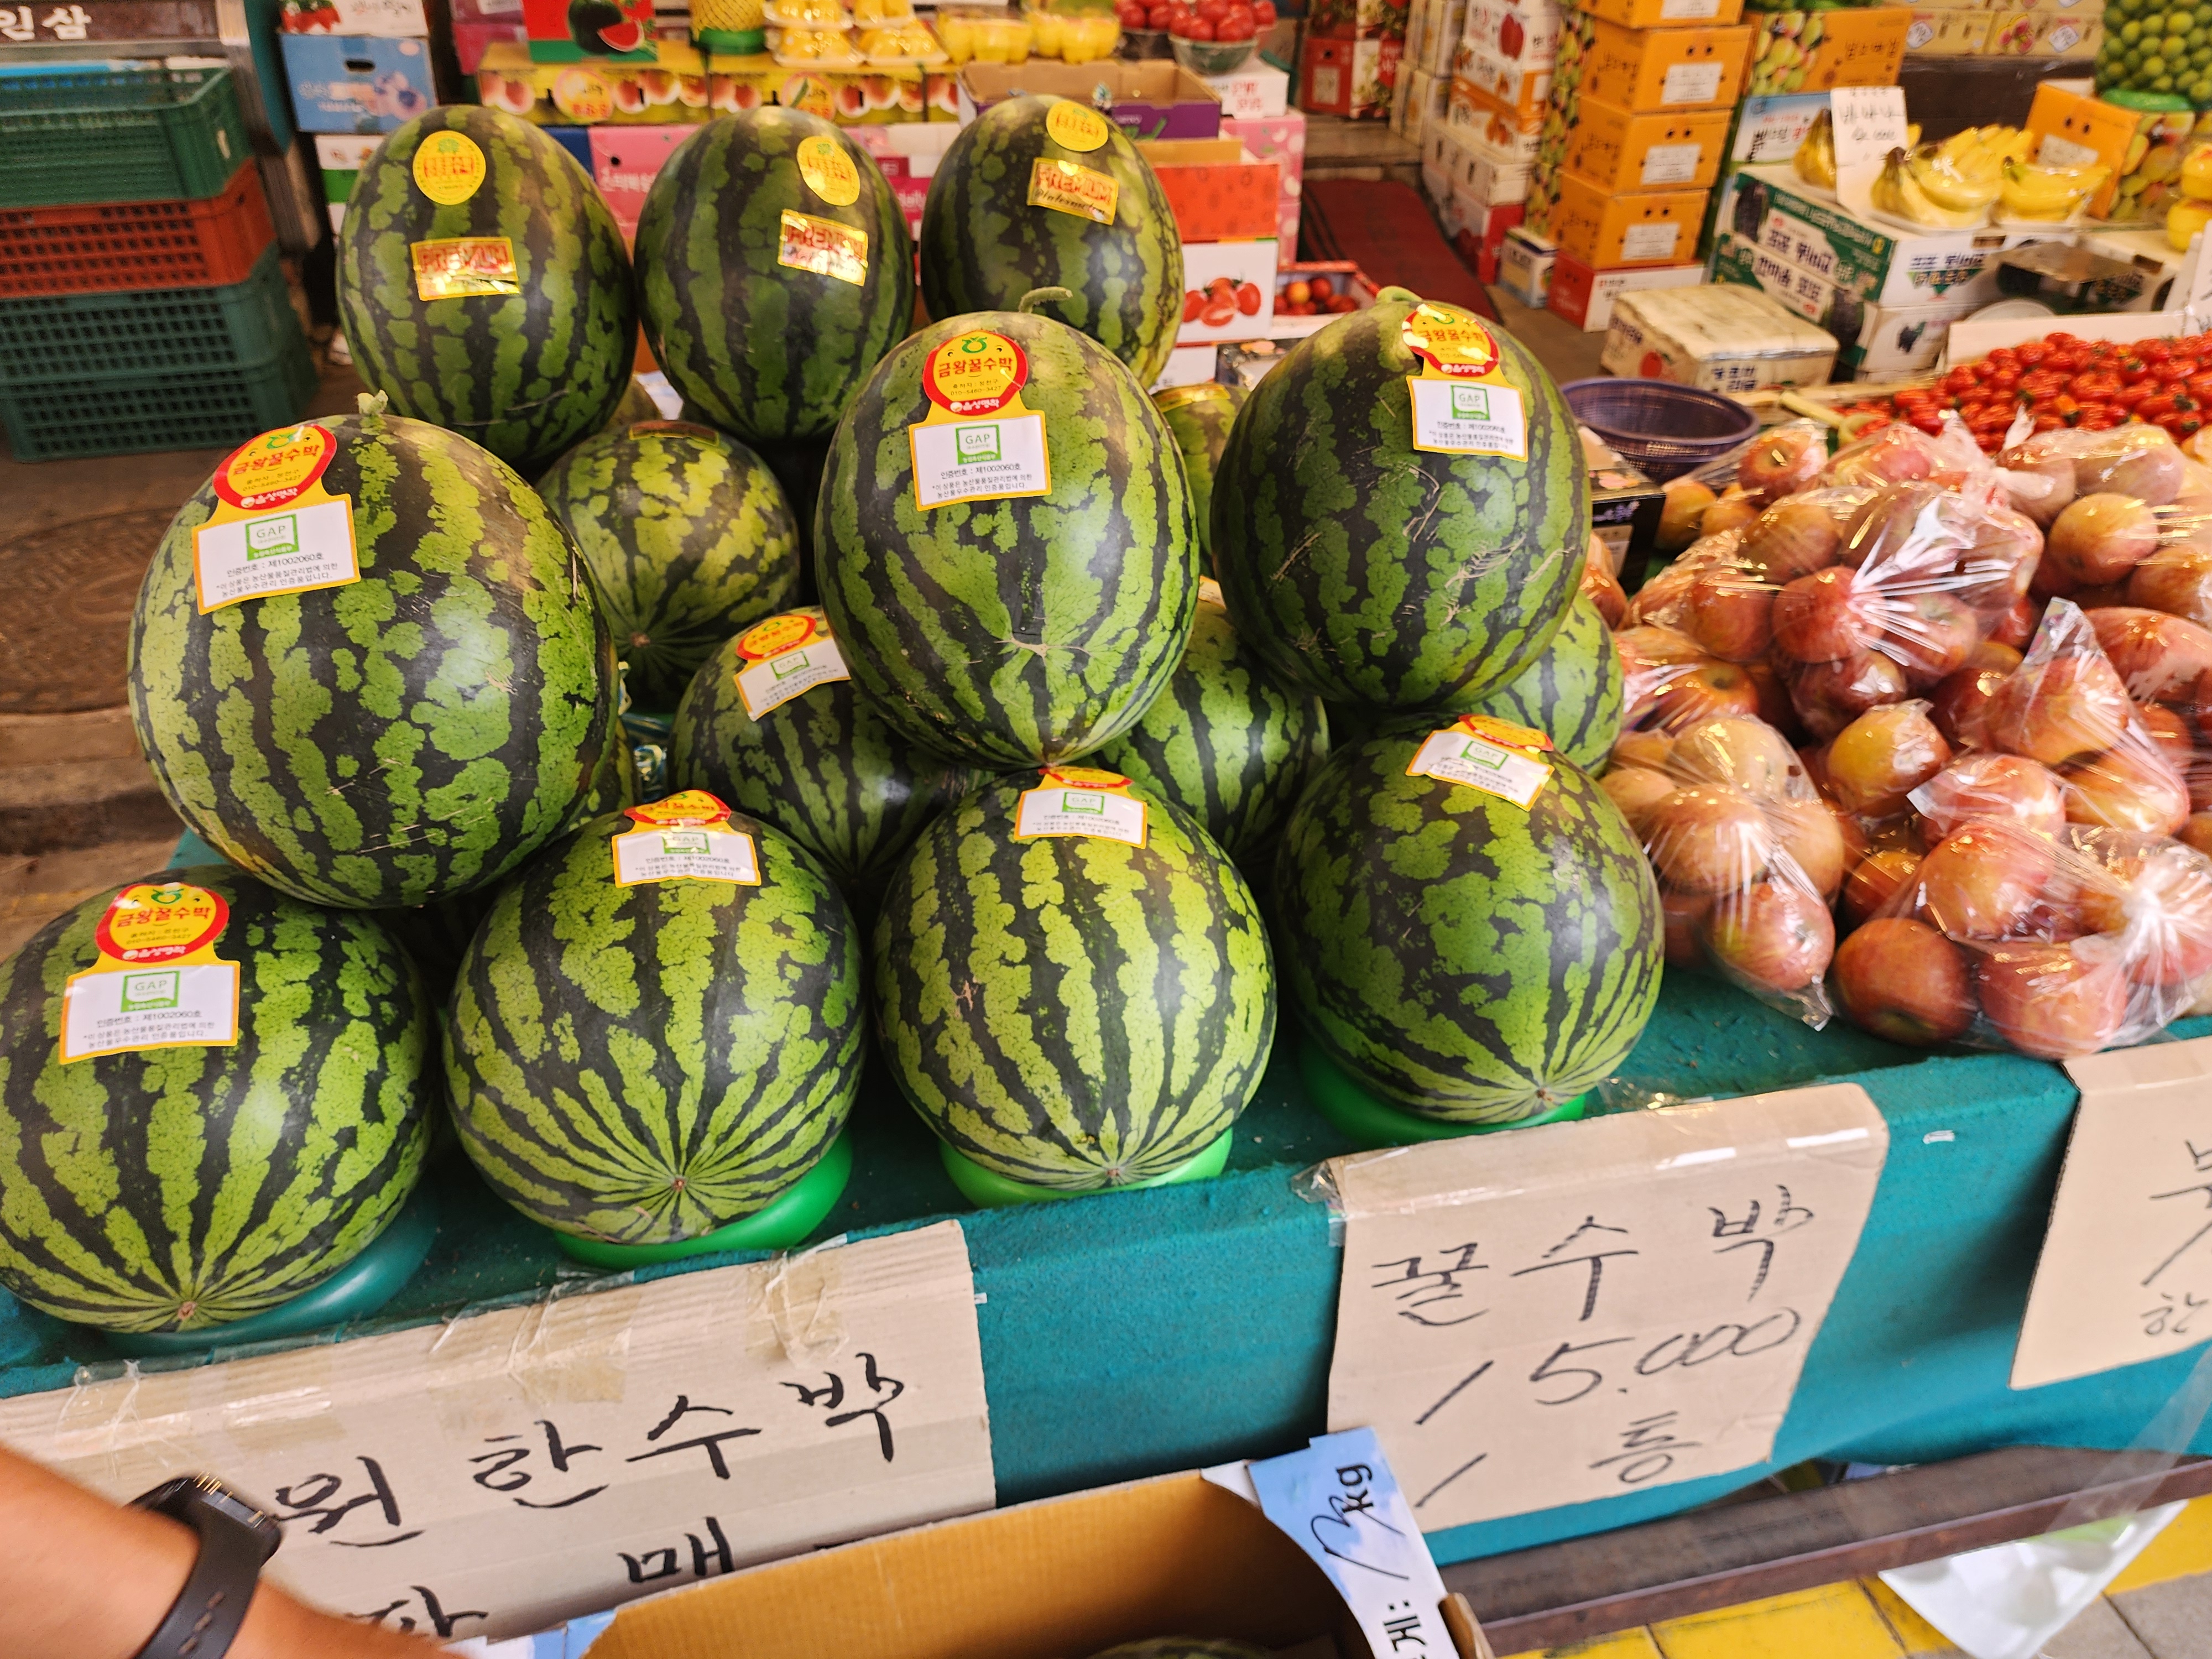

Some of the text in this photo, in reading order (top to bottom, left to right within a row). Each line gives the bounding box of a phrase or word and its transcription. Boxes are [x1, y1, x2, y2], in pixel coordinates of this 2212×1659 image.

[1035, 166, 1113, 206] PREMIUM
[939, 358, 1012, 378] 금왕꿀수박
[1459, 394, 1480, 403] GAP
[966, 434, 990, 444] GAP
[232, 445, 320, 476] 금왕꿀수박
[941, 468, 968, 479] 인증번호
[976, 463, 1021, 474] 제1002060호
[257, 525, 285, 538] GAP
[227, 564, 259, 577] 인증번호
[268, 552, 324, 567] 제1002060호
[117, 907, 211, 928] 금왕꿀수박
[134, 980, 167, 991] GAP
[143, 1010, 202, 1021] 제1002060호
[1335, 1463, 1374, 1514] kg
[1383, 1600, 1427, 1659] 게:
